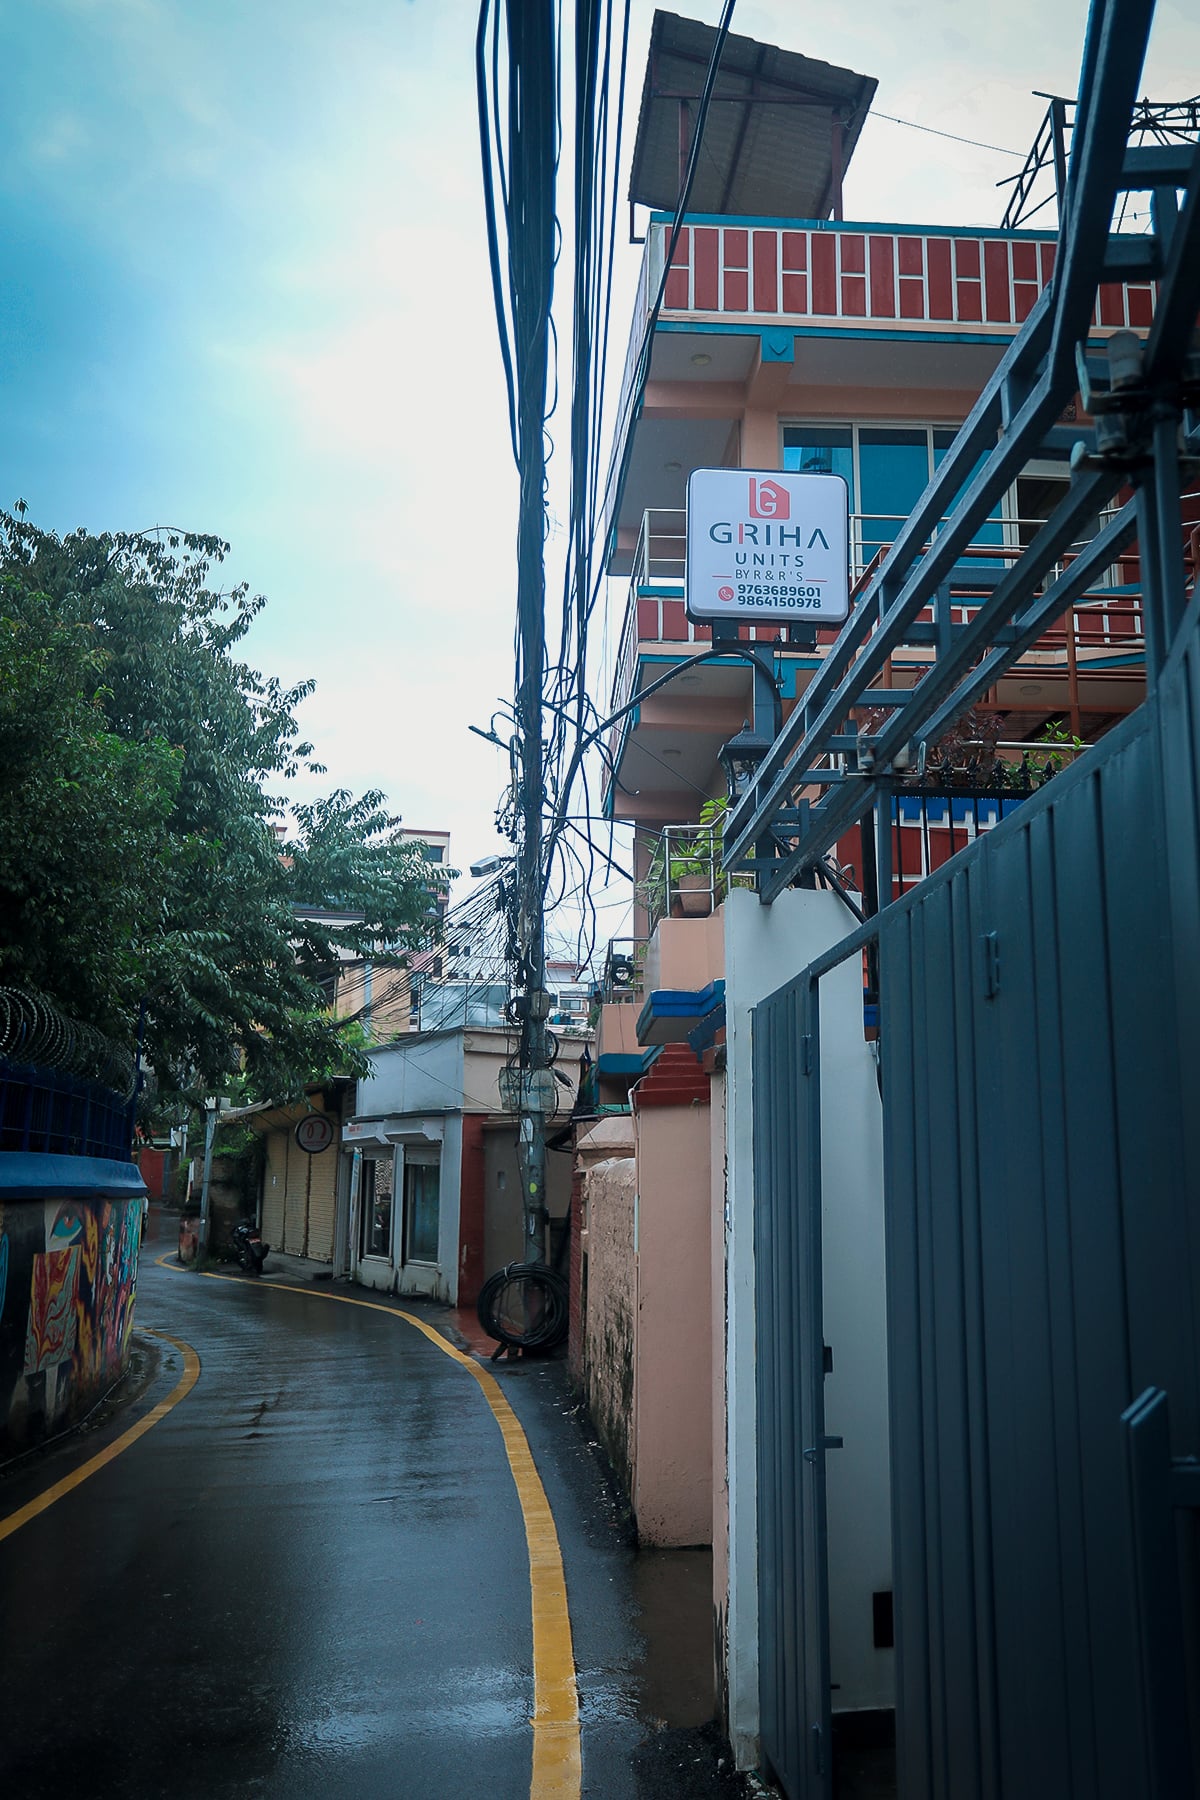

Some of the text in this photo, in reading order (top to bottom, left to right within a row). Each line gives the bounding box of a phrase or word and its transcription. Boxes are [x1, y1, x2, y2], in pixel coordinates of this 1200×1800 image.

[709, 522, 830, 550] GRIHA
[735, 552, 804, 567] UNITS
[738, 584, 821, 597] 9763689601
[738, 595, 821, 609] 9864150978
